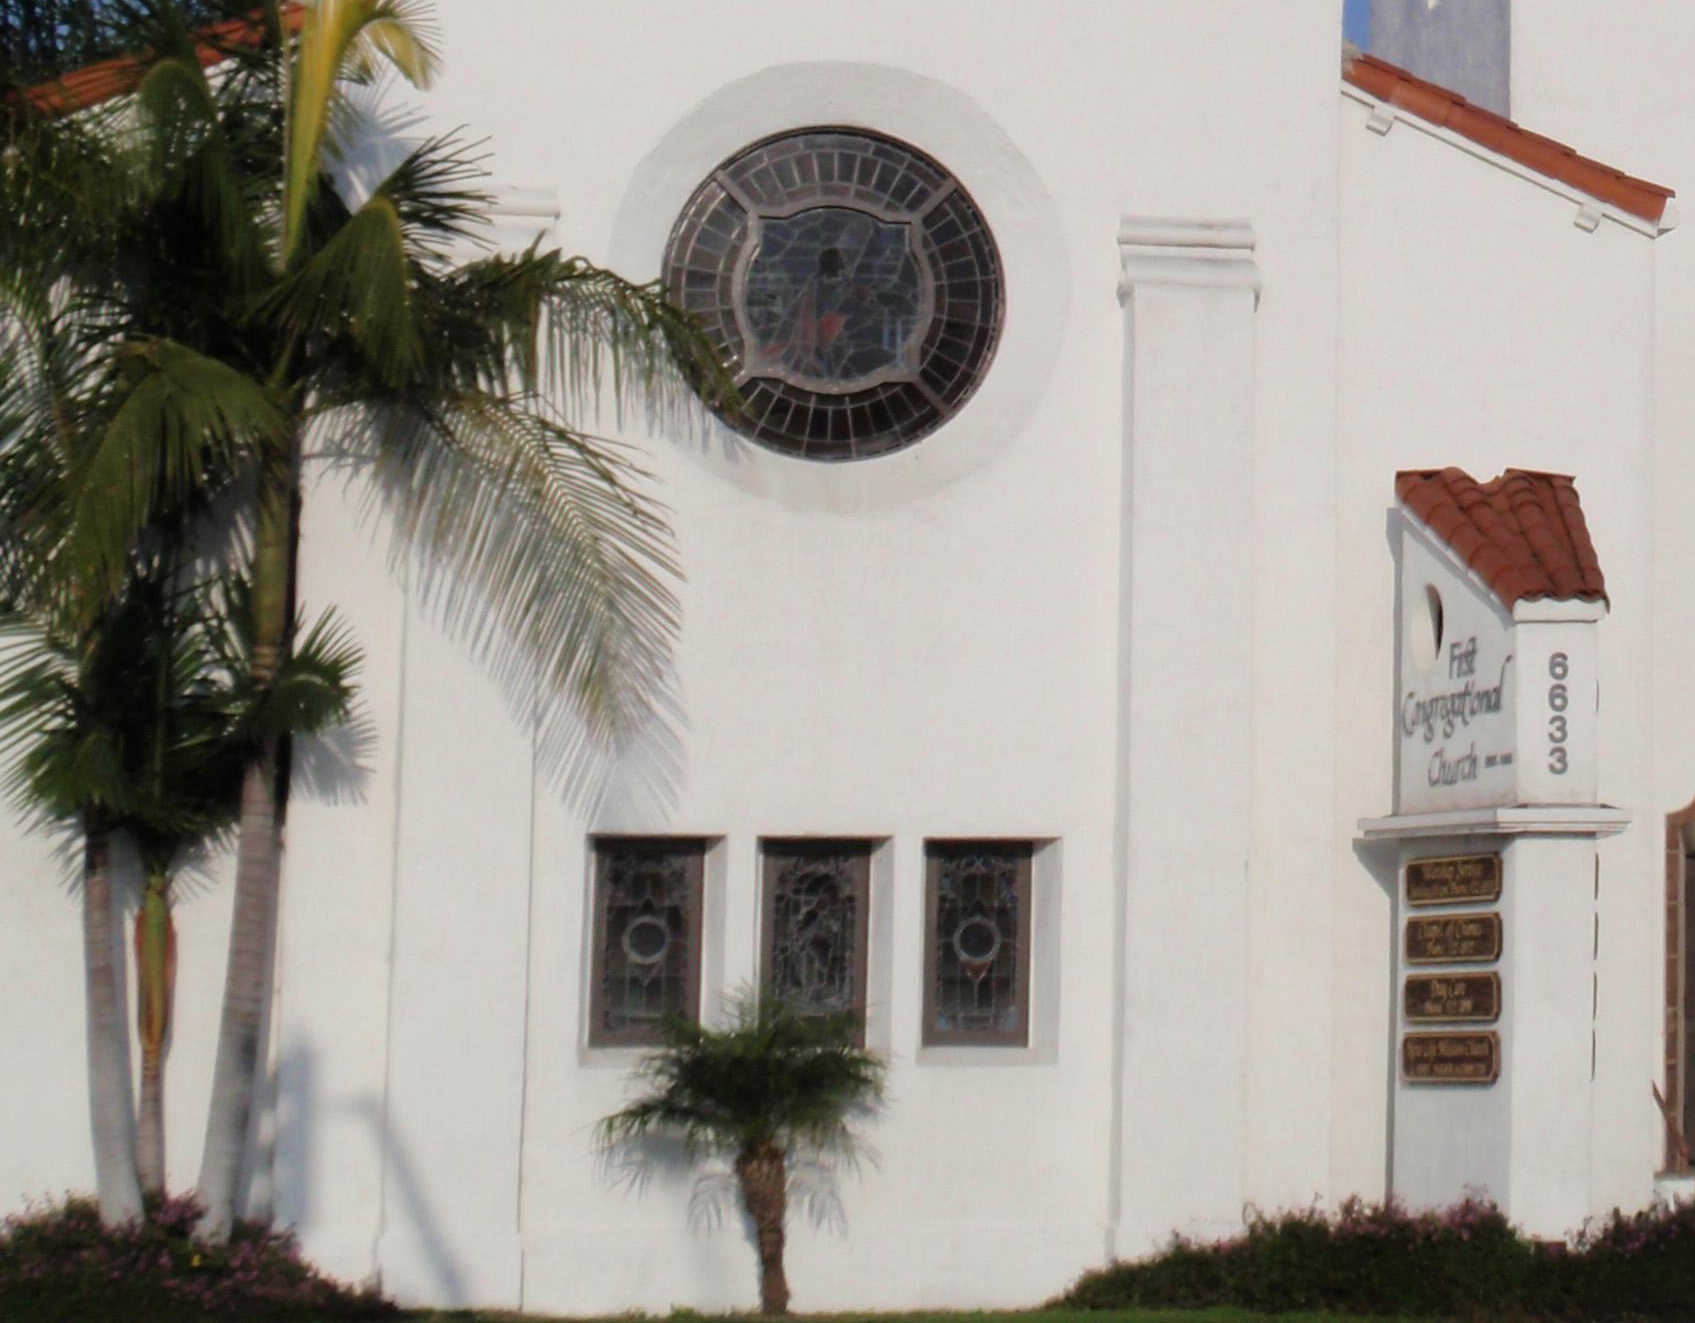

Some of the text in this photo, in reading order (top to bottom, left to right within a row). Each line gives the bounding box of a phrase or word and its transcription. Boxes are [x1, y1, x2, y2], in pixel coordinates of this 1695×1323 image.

[1449, 636, 1476, 679] First
[1403, 654, 1513, 743] Congregational
[1548, 651, 1569, 775] 6633
[1428, 741, 1477, 787] Church
